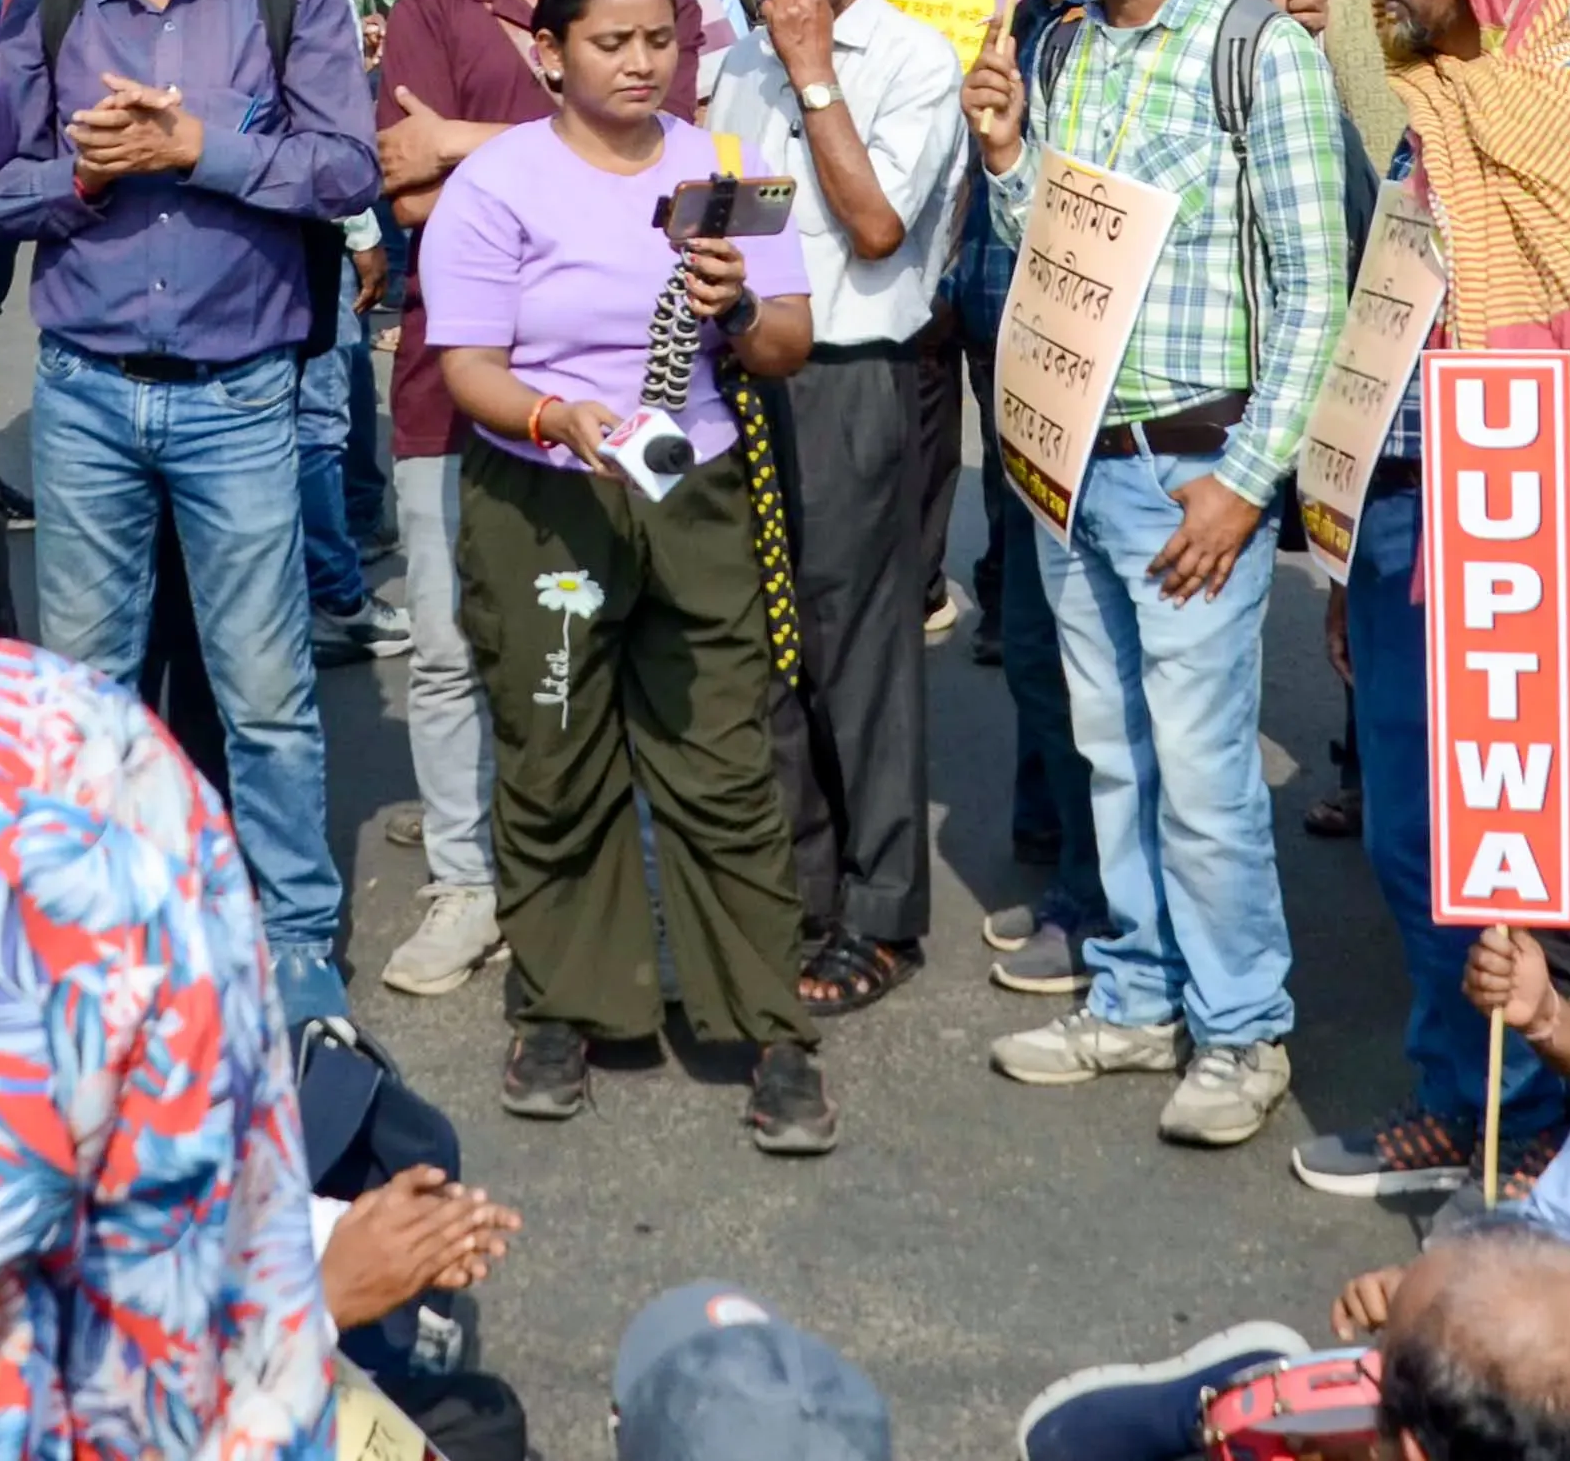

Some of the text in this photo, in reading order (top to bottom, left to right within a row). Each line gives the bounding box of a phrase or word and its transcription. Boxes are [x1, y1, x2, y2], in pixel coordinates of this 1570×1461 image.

[1044, 170, 1128, 242] অনিয়মিত
[1028, 244, 1114, 322] কর্মচারীদের
[1453, 379, 1554, 904] UUPTWA
